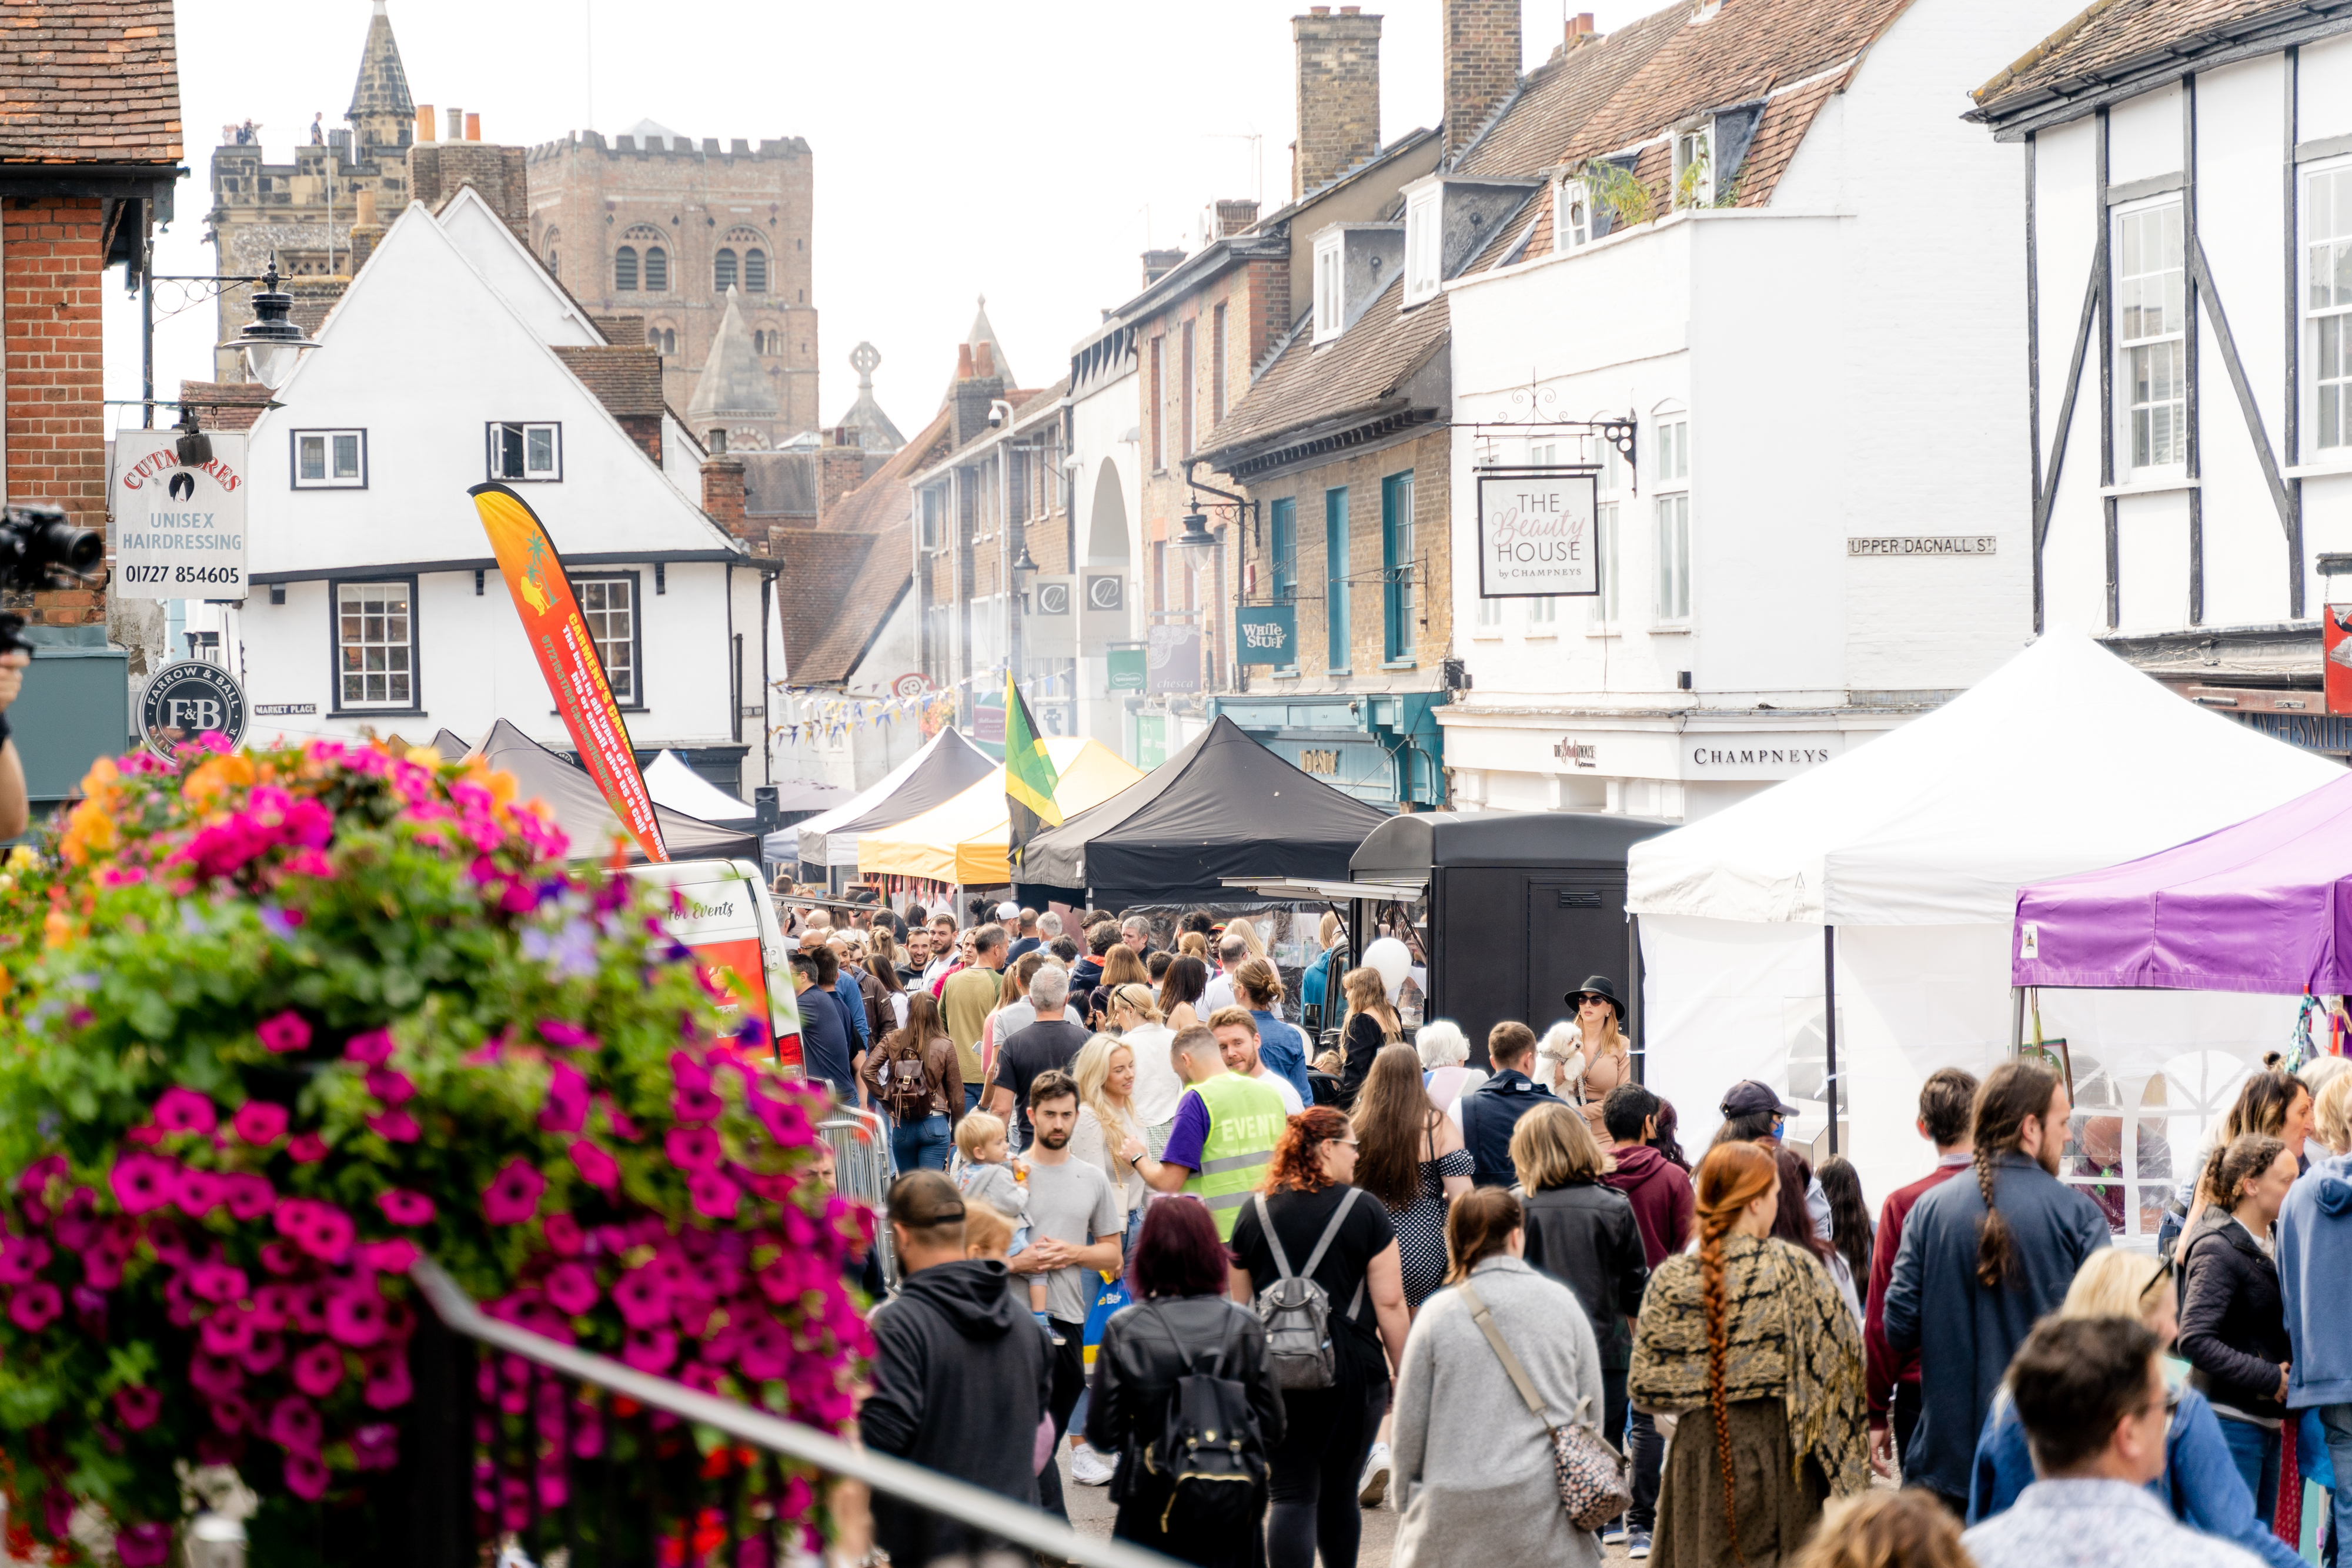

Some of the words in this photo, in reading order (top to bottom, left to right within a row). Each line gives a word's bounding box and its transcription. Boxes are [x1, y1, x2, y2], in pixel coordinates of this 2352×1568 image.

[123, 449, 241, 492] CUTMRES
[1517, 494, 1559, 513] THE
[151, 513, 214, 528] UNISEX
[1492, 507, 1585, 549] Beauty
[123, 533, 241, 550] HAIRDRESSING
[1852, 539, 1898, 553] UPPER
[1905, 539, 1971, 553] DAGNALL
[1498, 541, 1580, 561] HOUSE
[126, 565, 169, 583] 01727
[175, 566, 239, 583] 854605
[1499, 569, 1509, 579] by
[1512, 569, 1581, 577] CHAMPNEYS
[569, 613, 611, 704] CARMENS'S
[542, 634, 576, 704] 07721531769
[148, 667, 198, 705] FARROW
[203, 669, 212, 679] &
[215, 676, 240, 708] BALL
[1157, 678, 1193, 688] chesca
[166, 698, 221, 730] F&B
[256, 706, 288, 714] MARKET
[290, 705, 315, 713] PLACE
[562, 624, 575, 650] The
[573, 650, 587, 682] best
[584, 681, 593, 697] in
[590, 697, 603, 716] all
[599, 715, 618, 753] types
[616, 753, 627, 767] of
[623, 767, 652, 822] catering
[571, 671, 583, 695] big
[580, 696, 589, 710] or
[586, 711, 608, 751] small,
[604, 751, 622, 779] give
[619, 779, 630, 797] us
[627, 797, 635, 808] a
[632, 808, 647, 834] call
[1578, 745, 1595, 758] HOUSE
[1694, 748, 1828, 764] CHAMPNEYS
[693, 901, 734, 919] Events
[906, 978, 924, 990] NIK
[1221, 1114, 1277, 1142] EVENT
